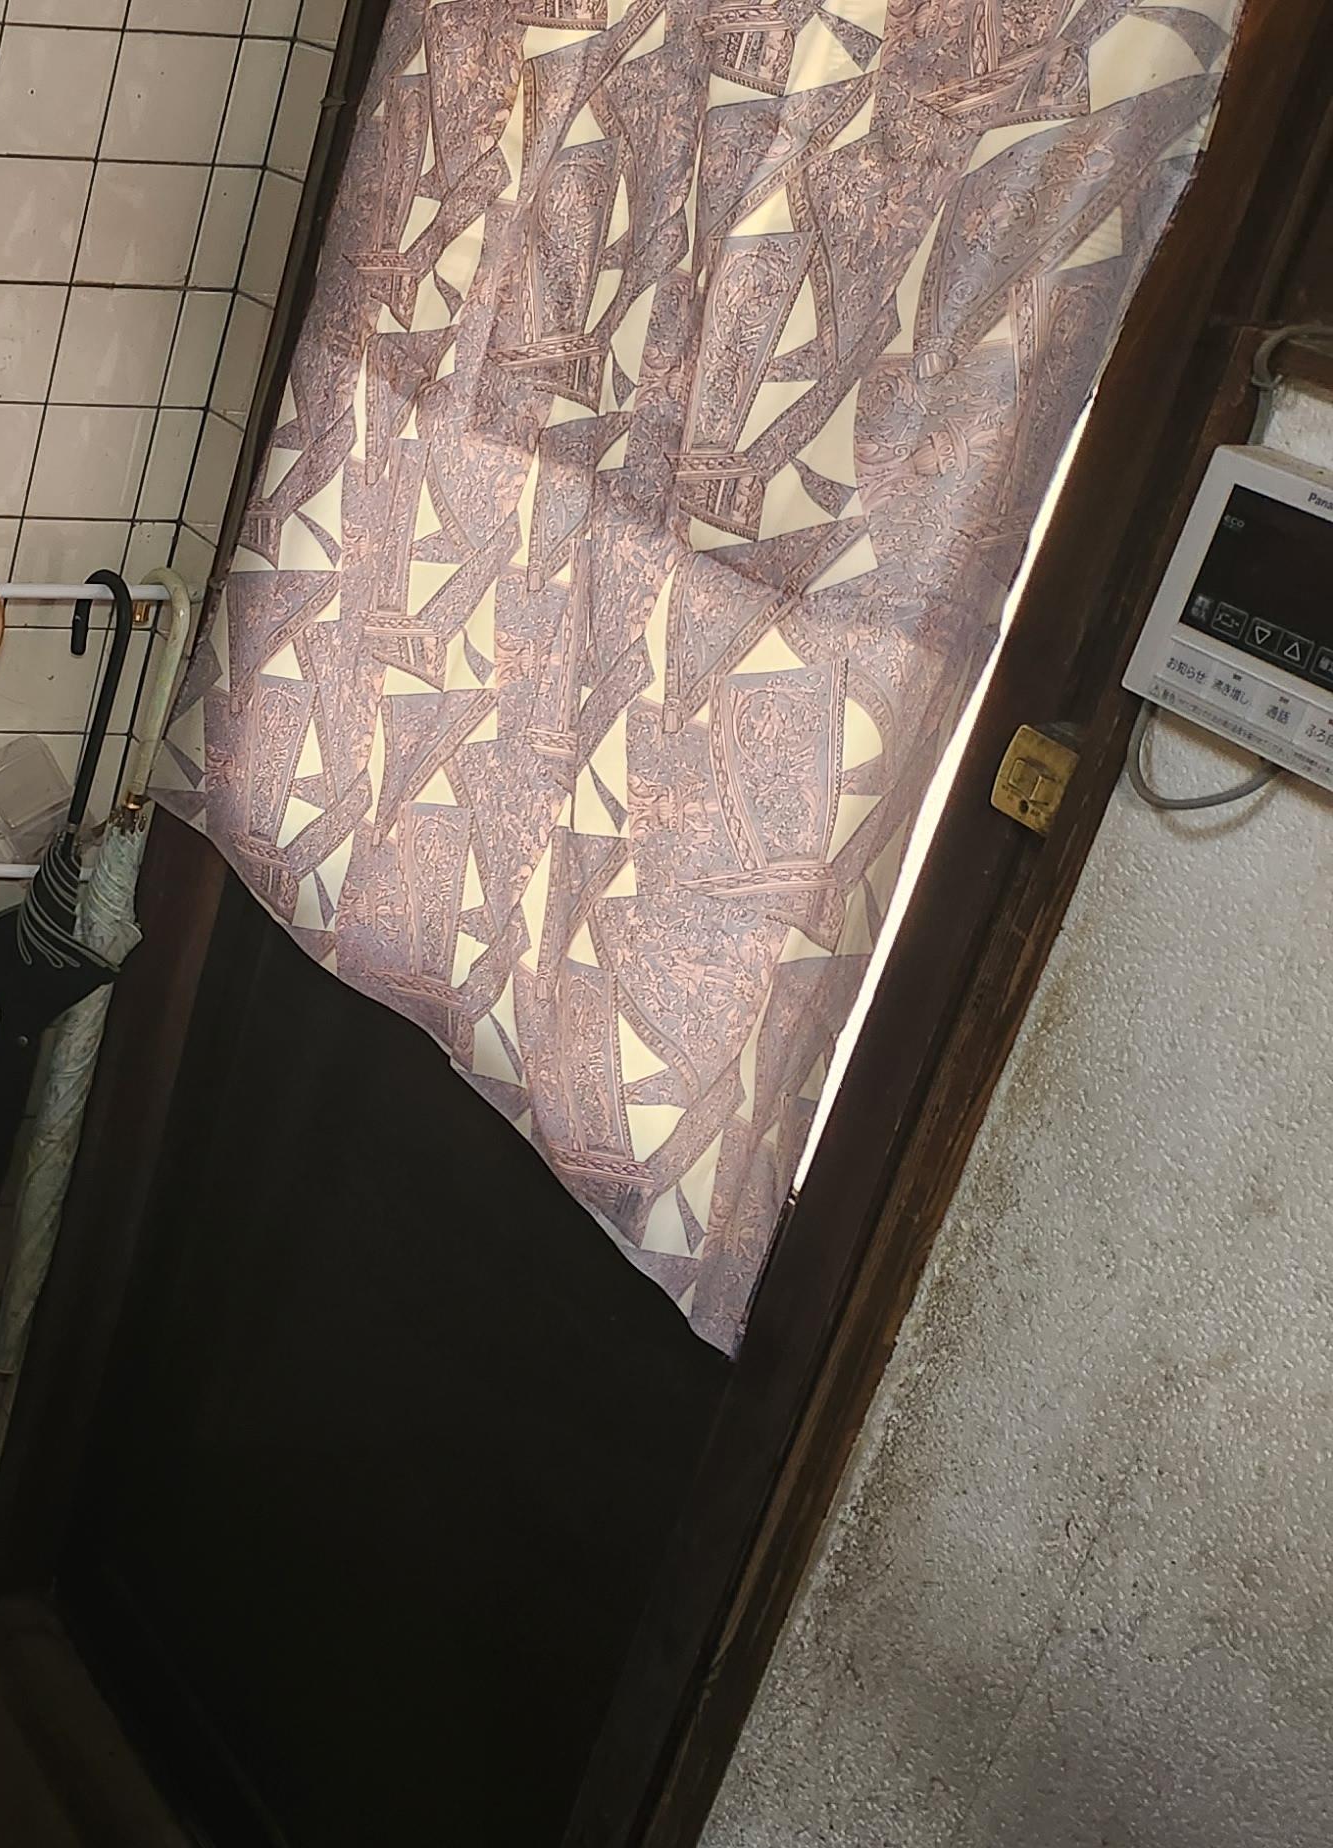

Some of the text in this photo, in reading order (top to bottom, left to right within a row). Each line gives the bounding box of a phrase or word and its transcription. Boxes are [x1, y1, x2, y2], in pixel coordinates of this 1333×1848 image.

[1223, 514, 1245, 528] eco
[1166, 657, 1206, 684] お知らせ
[1265, 704, 1291, 725] 通話
